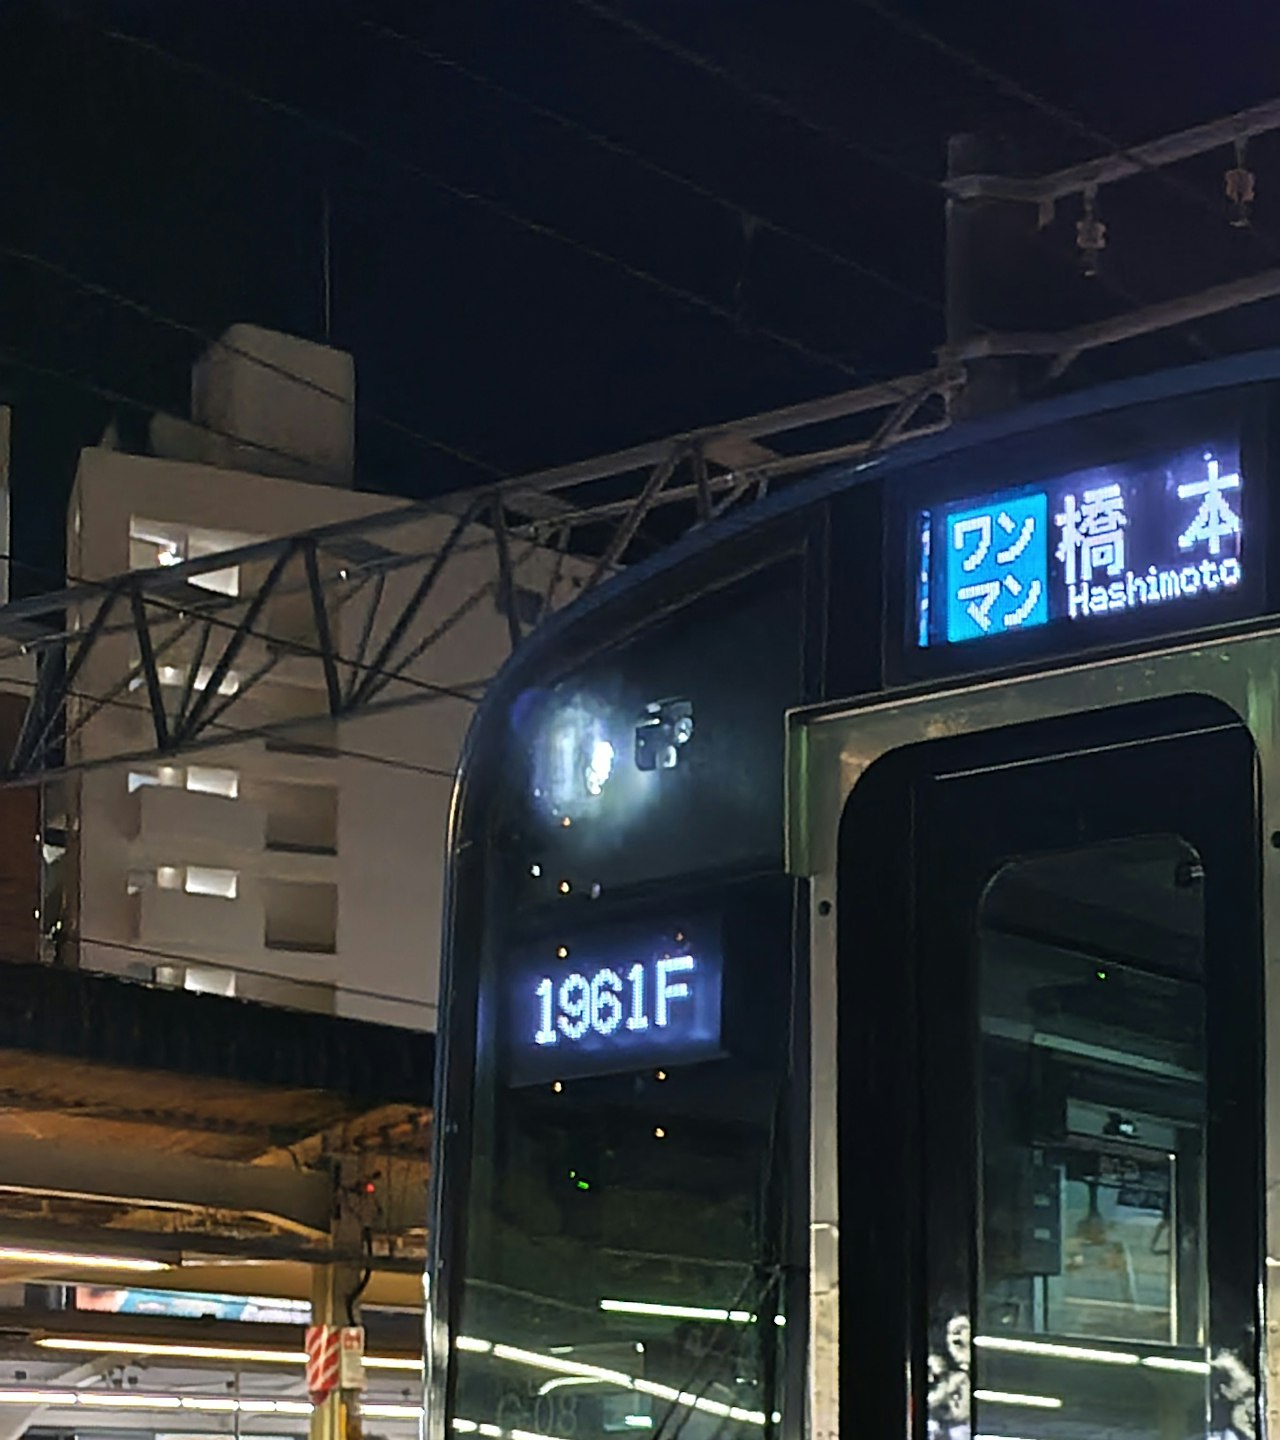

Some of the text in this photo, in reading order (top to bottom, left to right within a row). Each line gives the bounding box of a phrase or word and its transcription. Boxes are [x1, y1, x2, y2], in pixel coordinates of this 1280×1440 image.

[953, 510, 1036, 572] ワン
[1055, 457, 1241, 585] 橋本
[957, 574, 1042, 633] マン
[1067, 558, 1242, 619] Hashimoto
[534, 954, 695, 1045] 1961F
